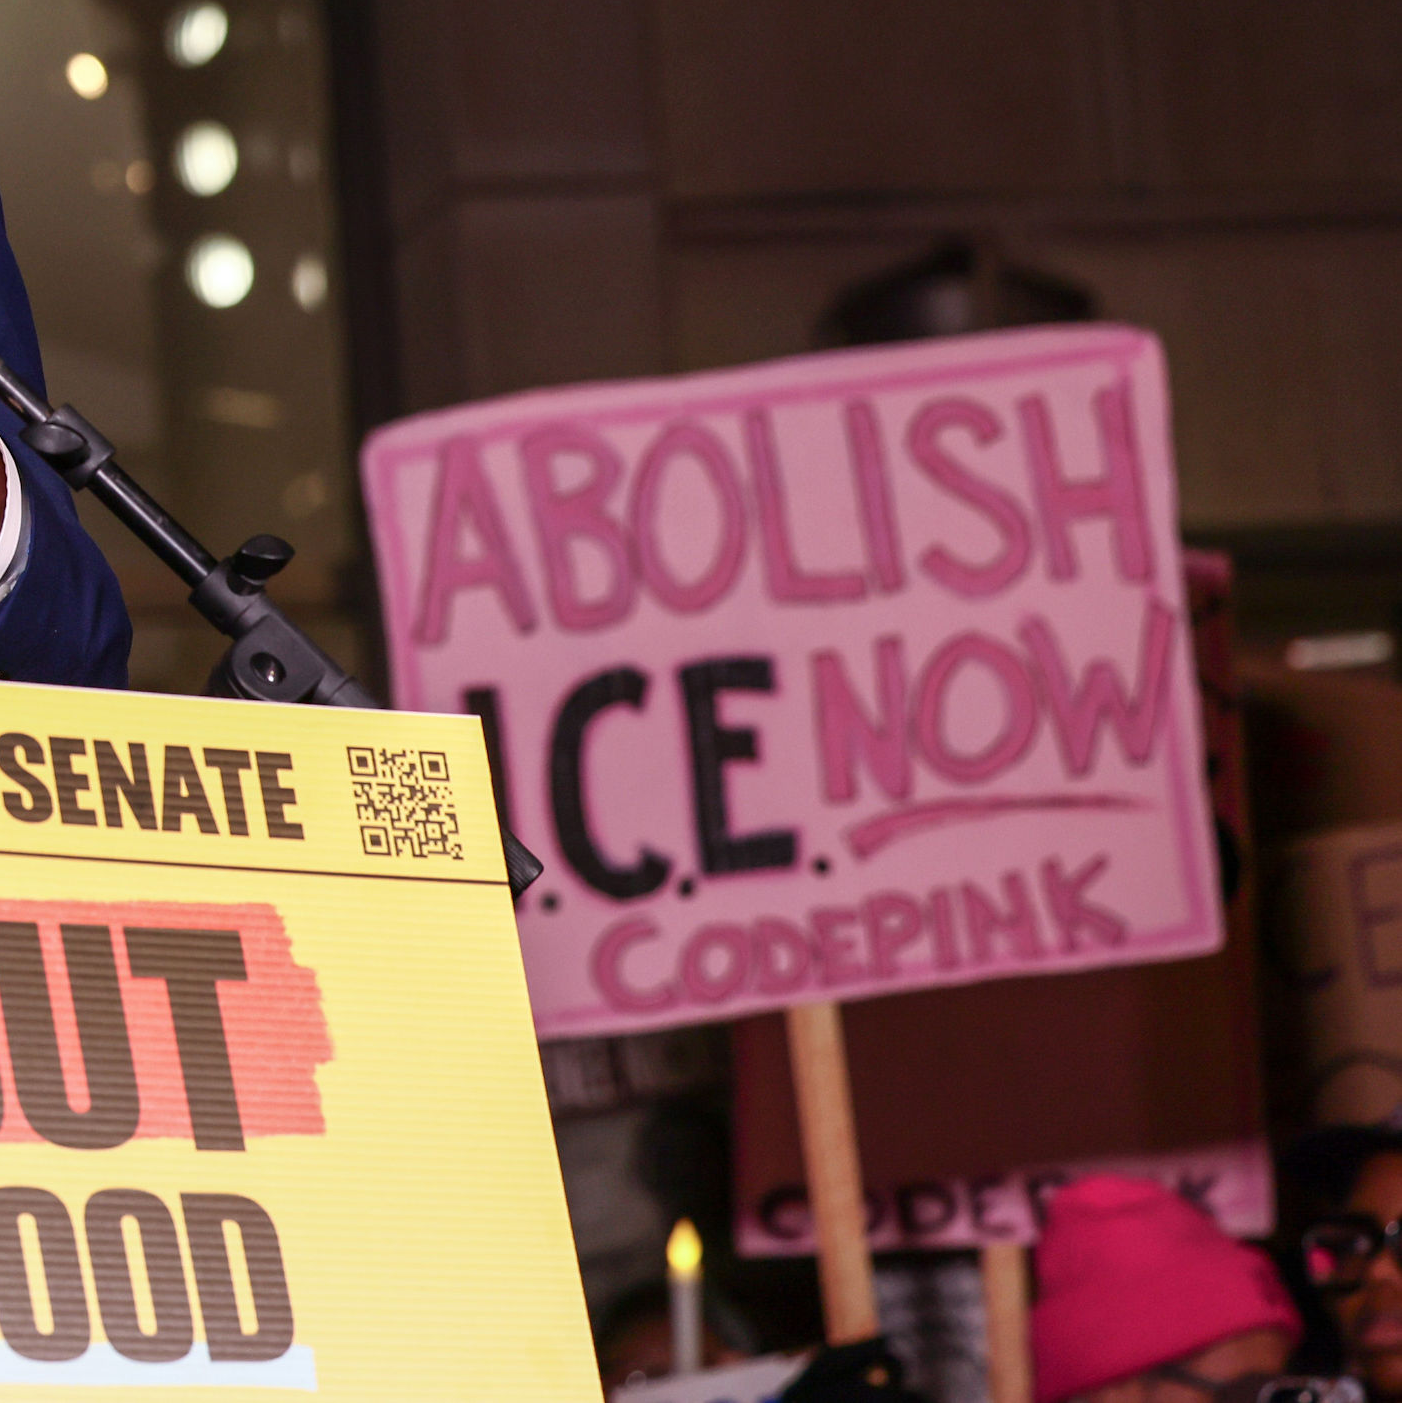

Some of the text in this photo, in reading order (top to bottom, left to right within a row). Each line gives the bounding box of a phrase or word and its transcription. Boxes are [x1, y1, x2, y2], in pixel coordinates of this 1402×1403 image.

[411, 376, 1155, 648] ABOLISH
[811, 602, 1176, 803] NOW
[589, 856, 1128, 1014] CODEPINK
